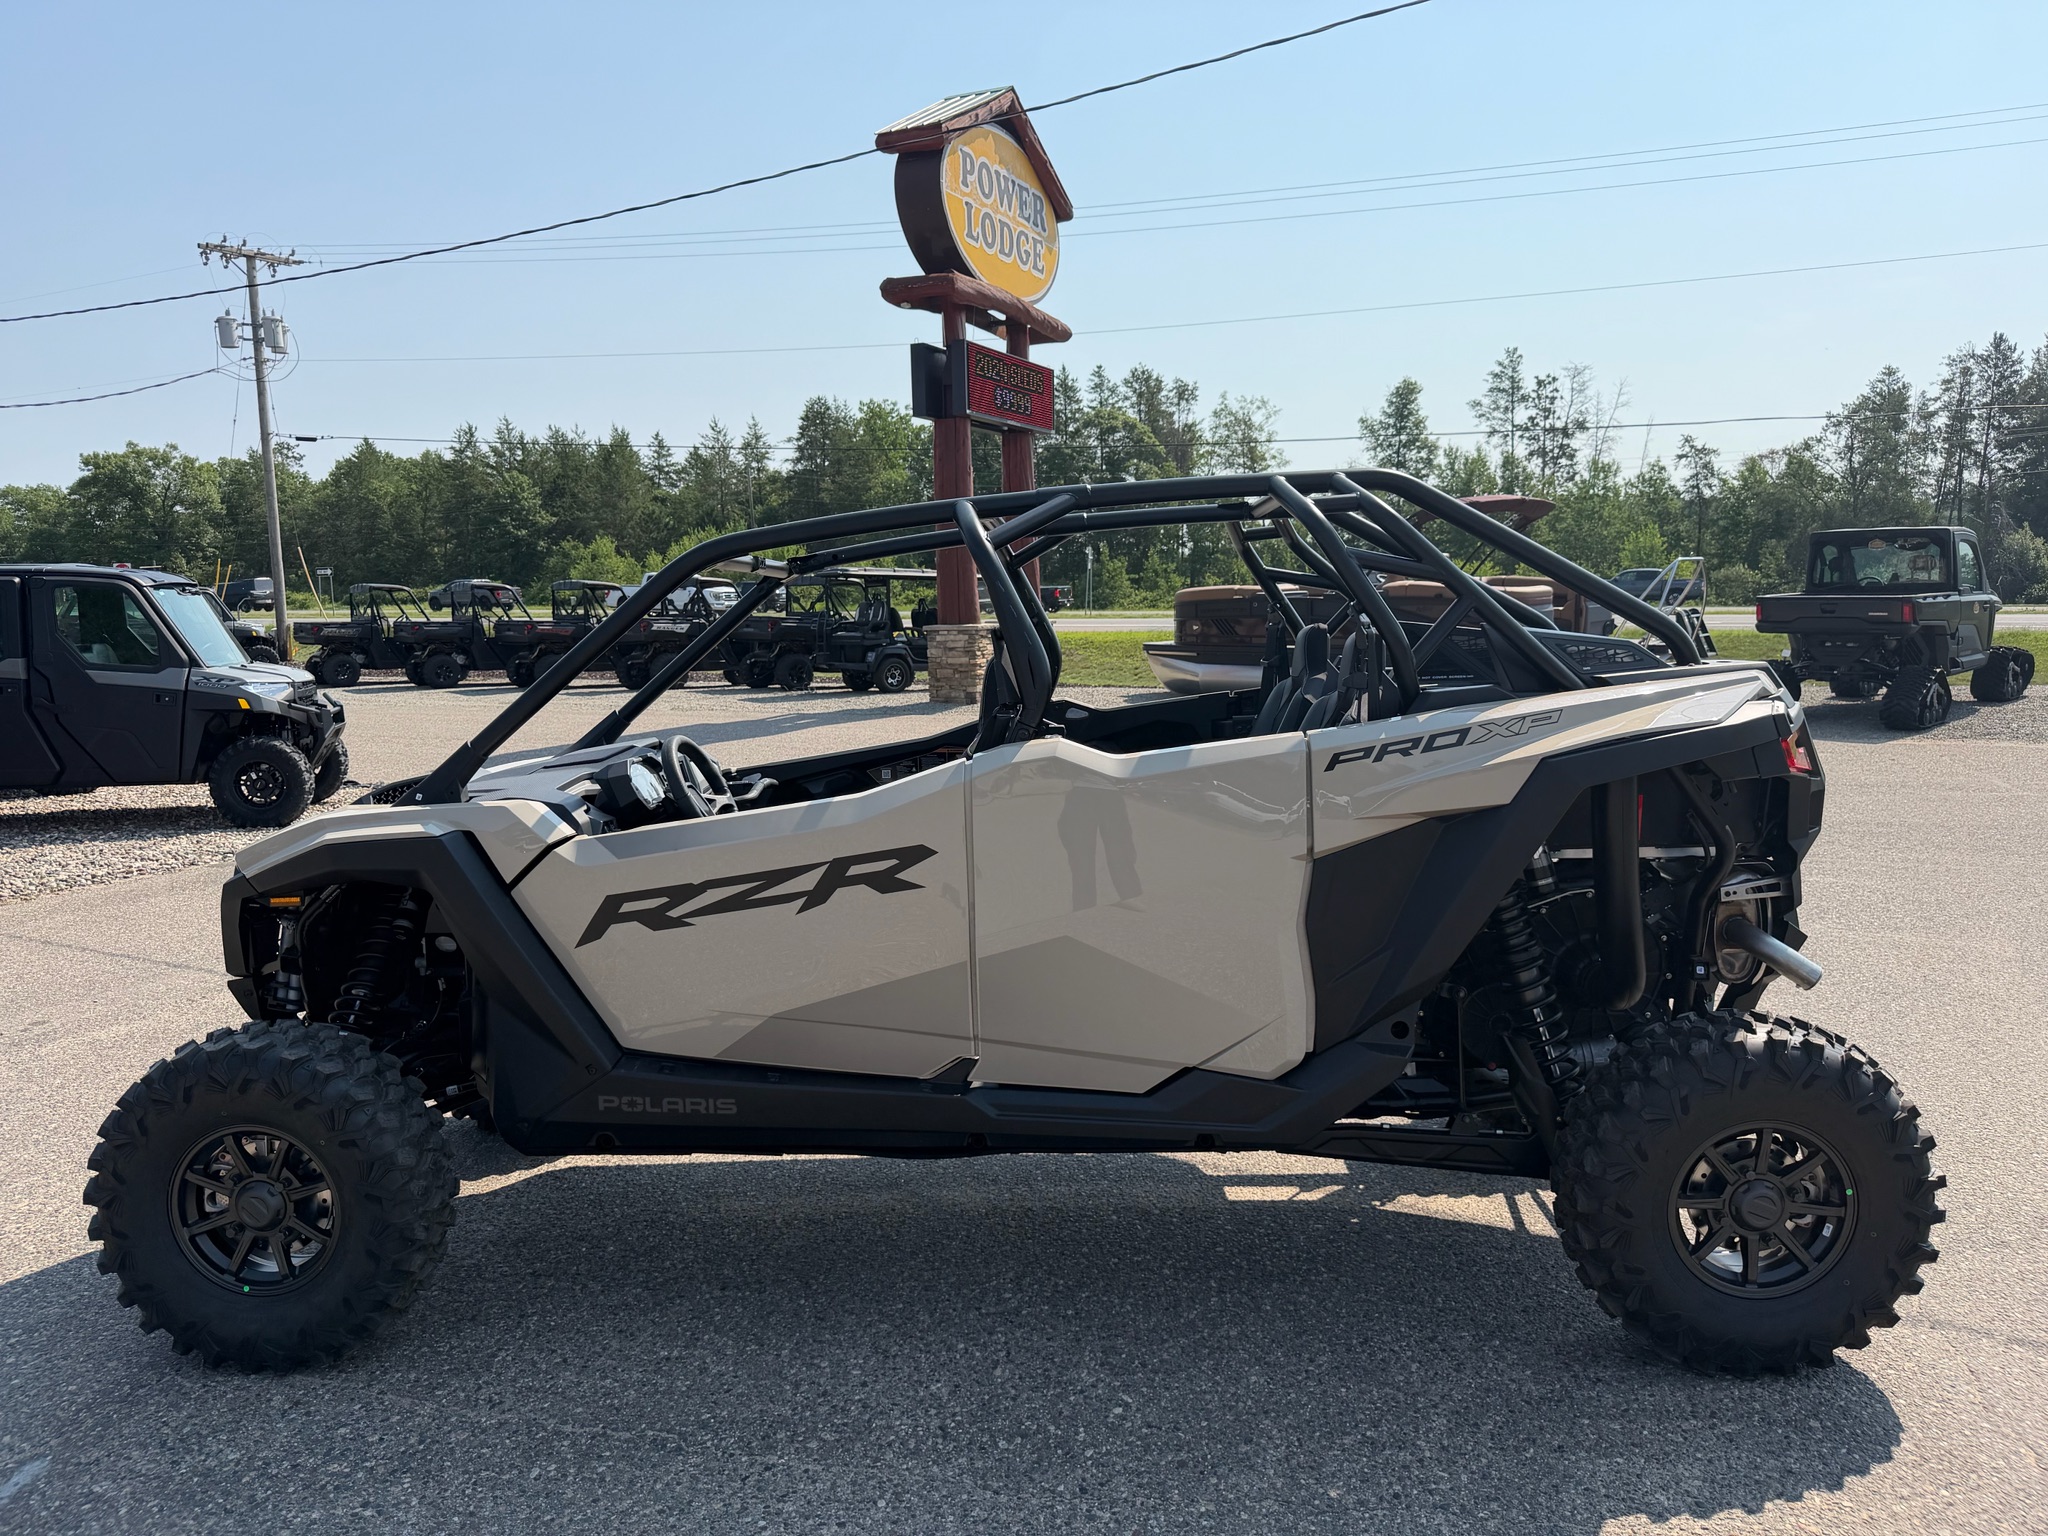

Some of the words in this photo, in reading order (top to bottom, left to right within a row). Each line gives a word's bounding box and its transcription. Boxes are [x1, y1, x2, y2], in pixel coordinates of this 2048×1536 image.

[959, 146, 1047, 235] POWER
[964, 200, 1045, 277] LODGE
[975, 354, 1008, 382] 2024
[574, 843, 939, 949] RZR
[598, 1095, 738, 1115] POLARIS
